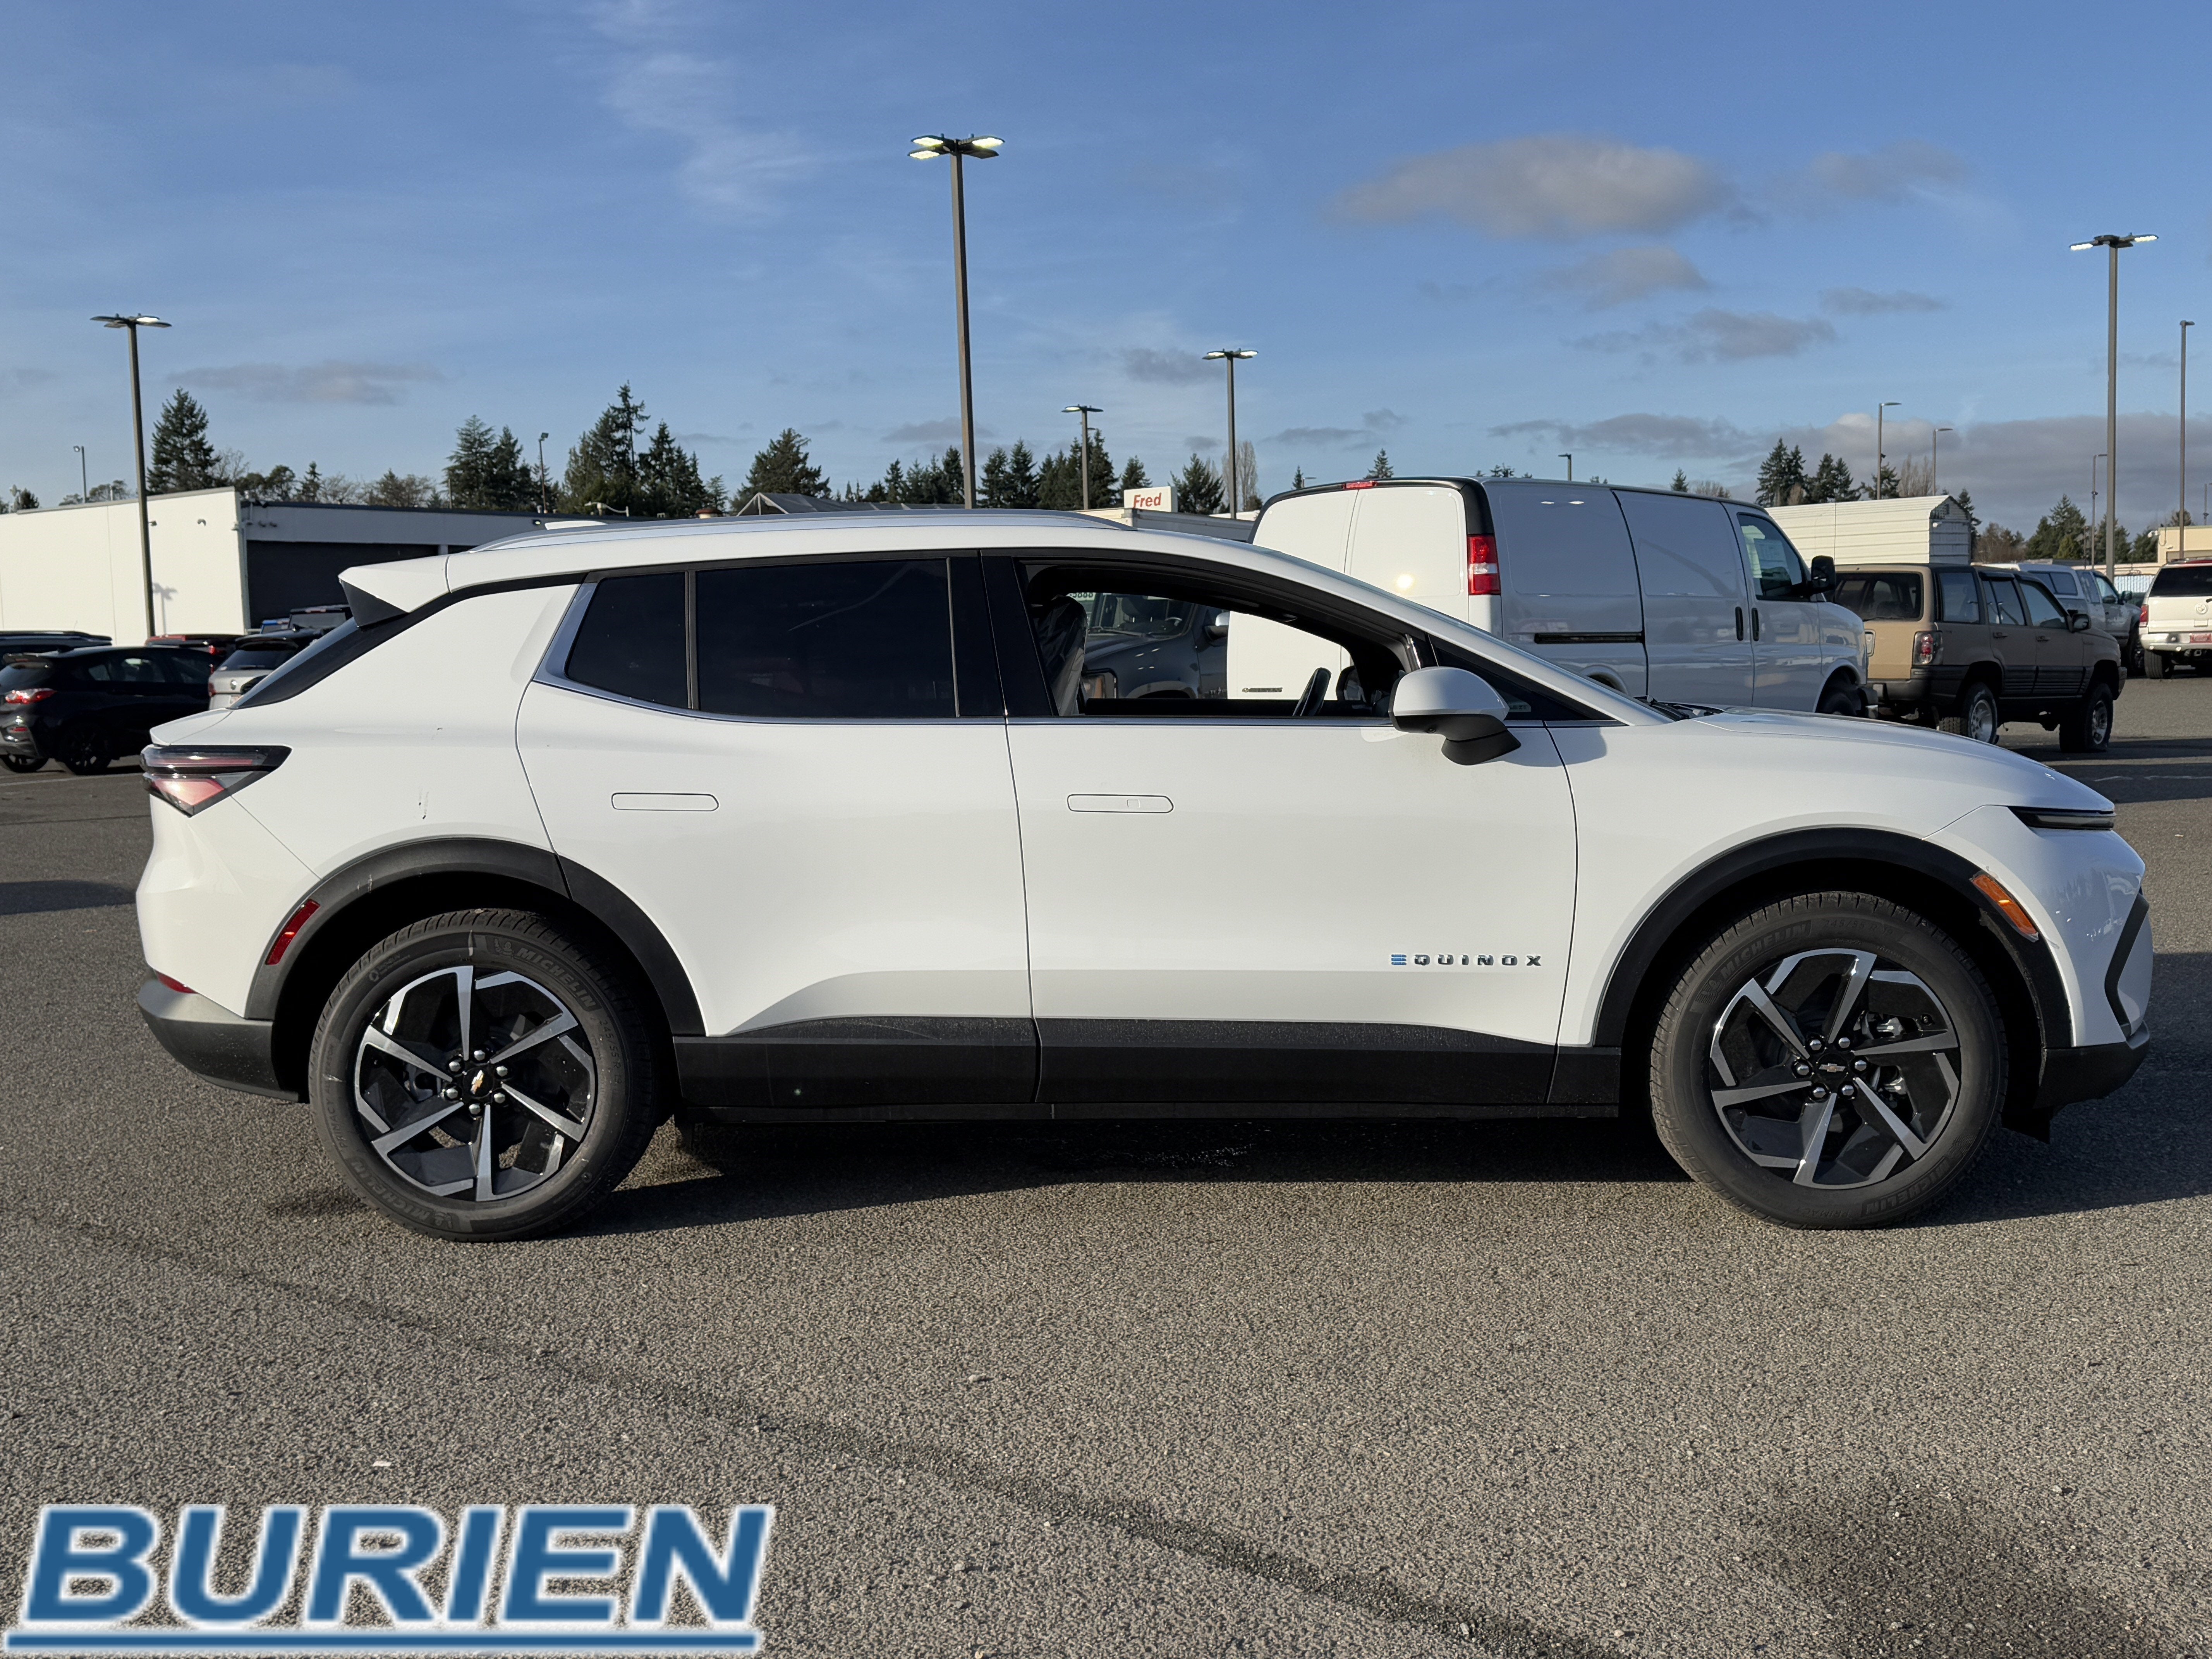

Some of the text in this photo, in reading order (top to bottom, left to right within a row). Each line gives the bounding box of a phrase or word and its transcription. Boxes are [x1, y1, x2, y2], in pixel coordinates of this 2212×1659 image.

[1133, 492, 1162, 508] Fred
[516, 946, 597, 1008] MICHELIN
[1391, 954, 1541, 967] EQUINOX
[1719, 923, 1807, 980] MICHELIN
[326, 1097, 348, 1152] PRIMACY
[350, 1160, 431, 1221] MICHELIN
